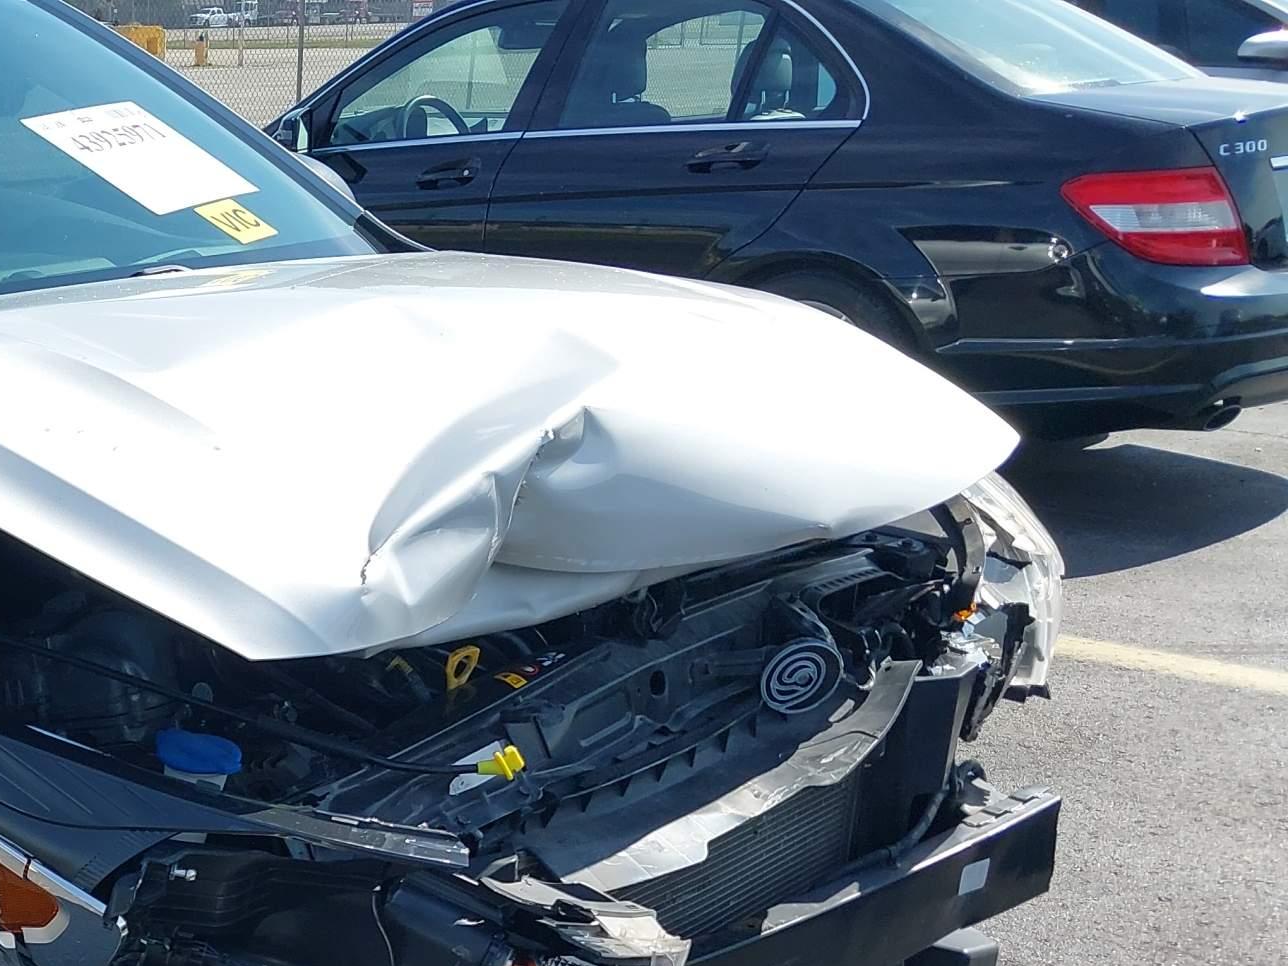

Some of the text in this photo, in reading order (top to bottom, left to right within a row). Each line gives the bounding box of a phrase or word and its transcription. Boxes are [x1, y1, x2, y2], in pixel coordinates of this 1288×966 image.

[70, 122, 167, 153] 43925971
[1219, 139, 1268, 156] C 300
[210, 209, 262, 233] VIC
